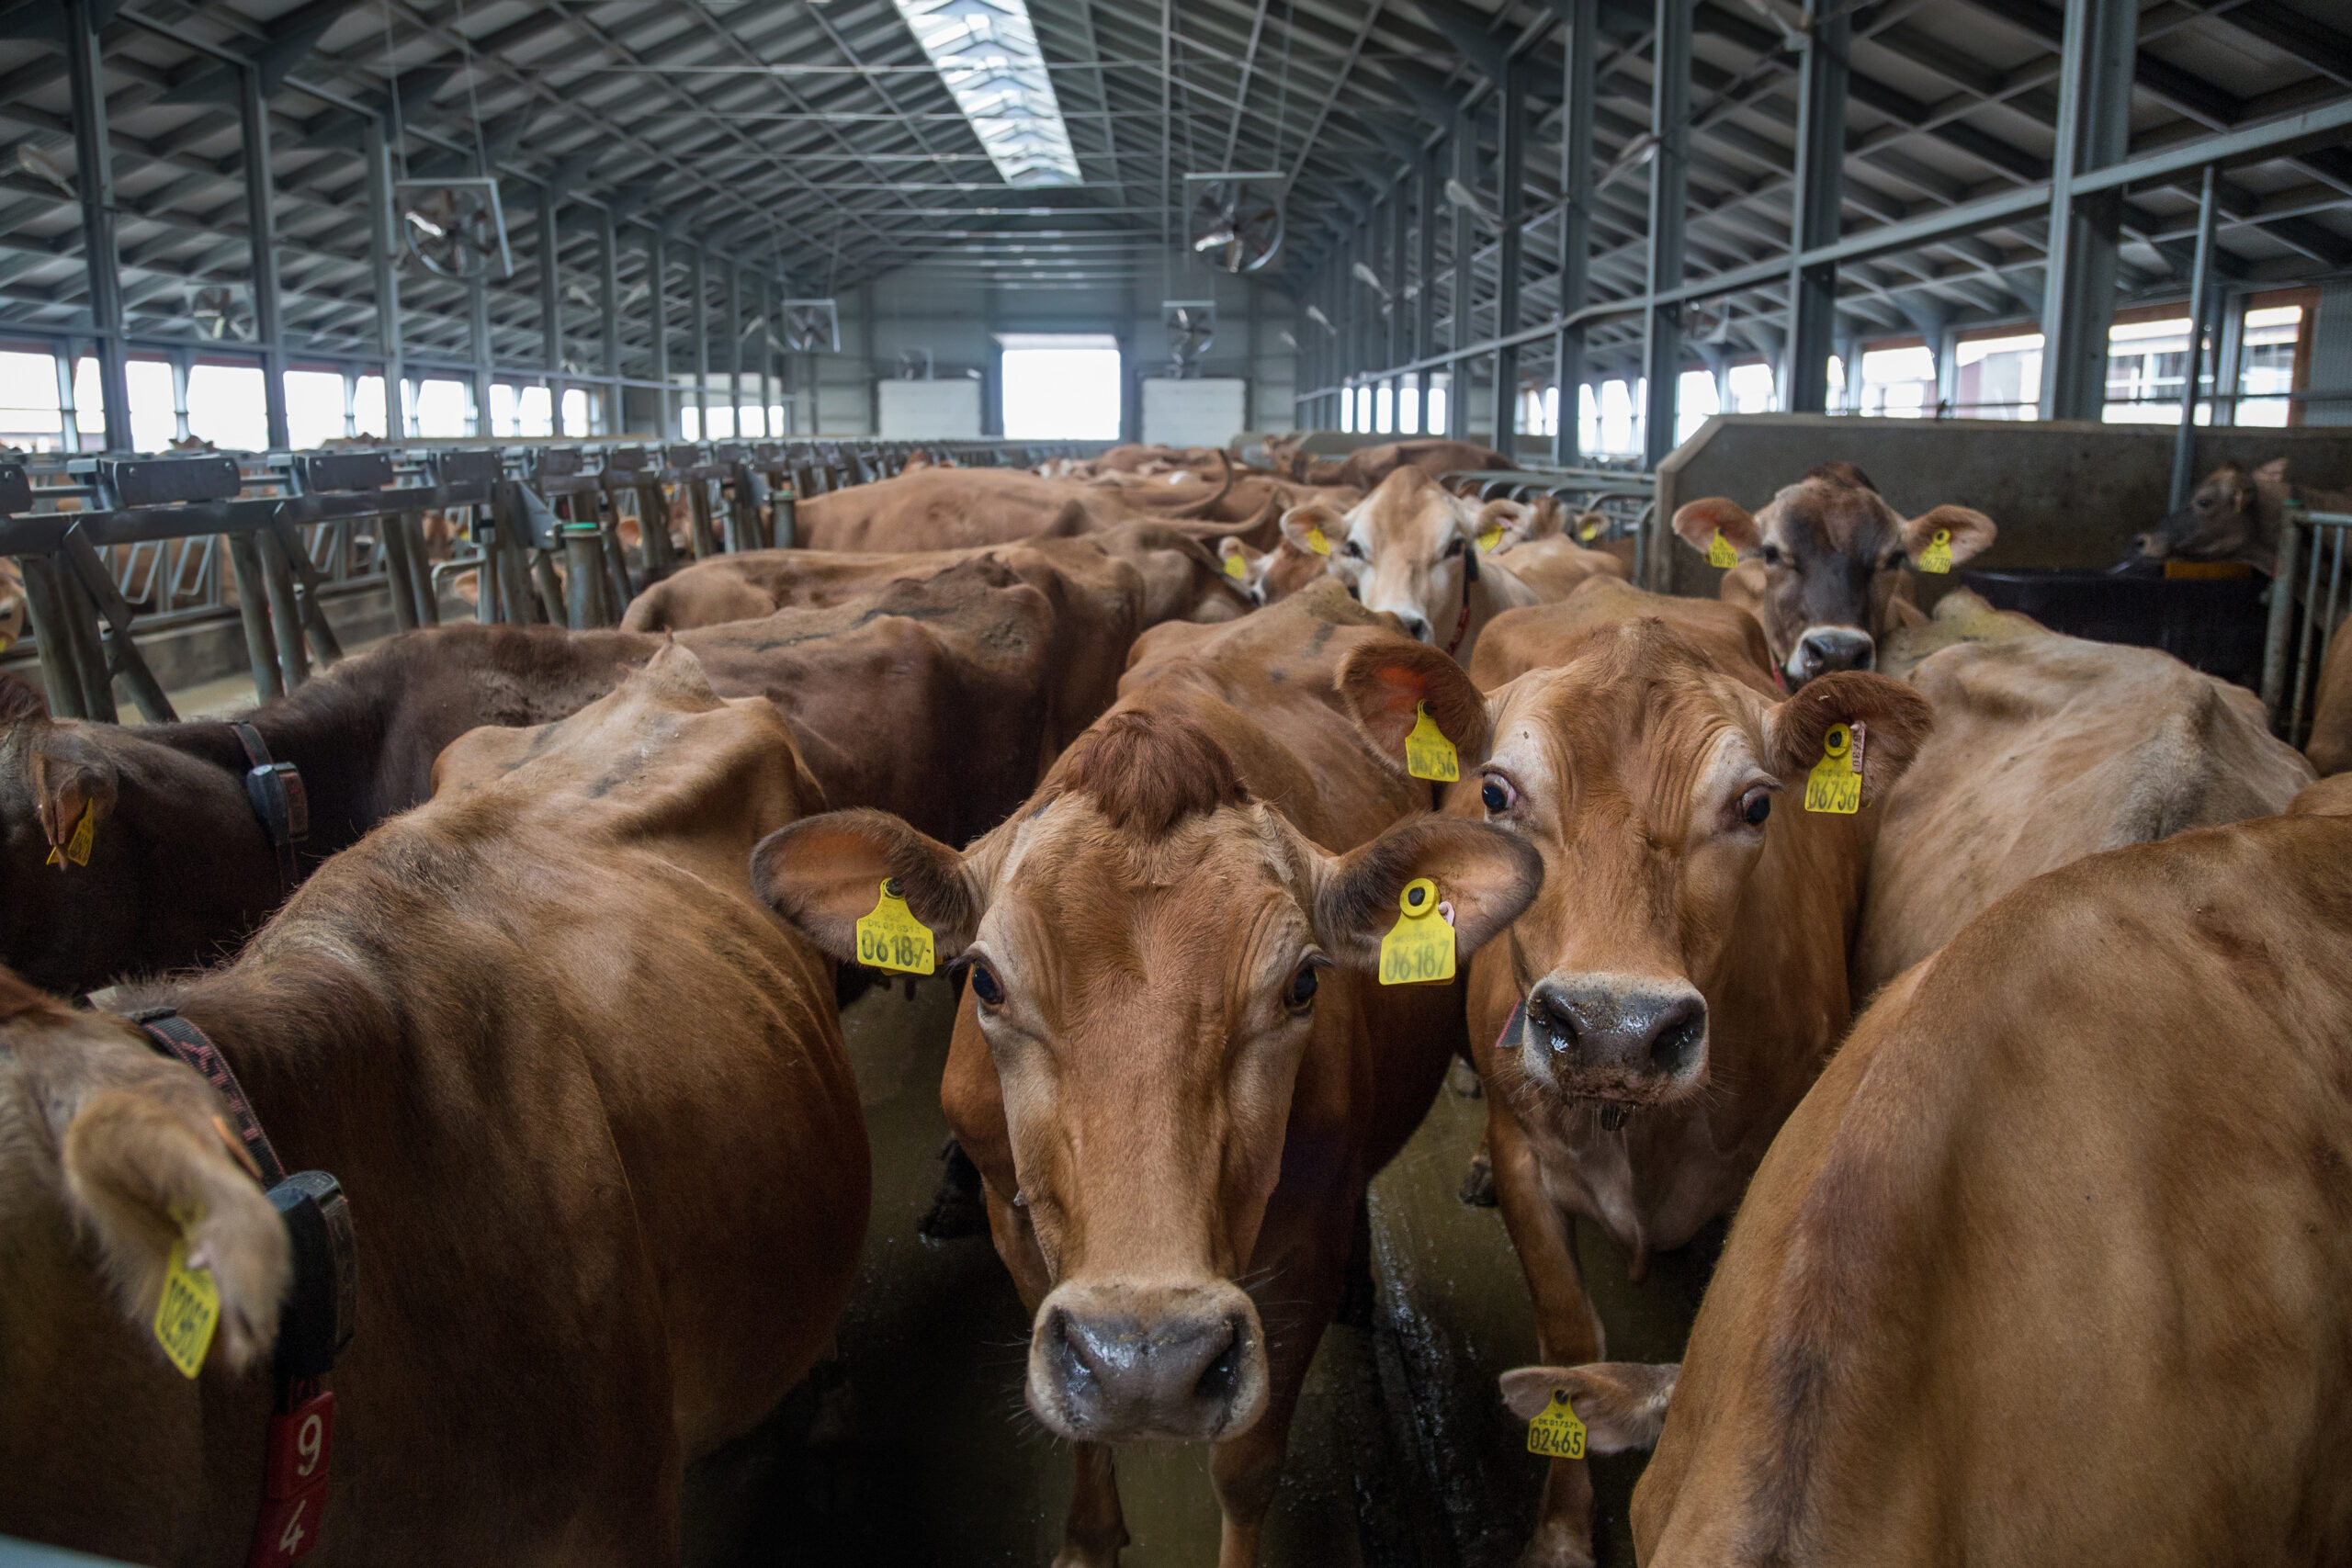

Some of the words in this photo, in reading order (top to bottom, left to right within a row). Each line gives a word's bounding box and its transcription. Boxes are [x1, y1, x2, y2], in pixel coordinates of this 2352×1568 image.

[1809, 781, 1857, 811] 06756
[862, 930, 926, 968] 06187
[1385, 941, 1450, 982] 06187
[297, 1414, 322, 1477] 9
[1531, 1427, 1582, 1455] 02465
[278, 1499, 308, 1556] 4
